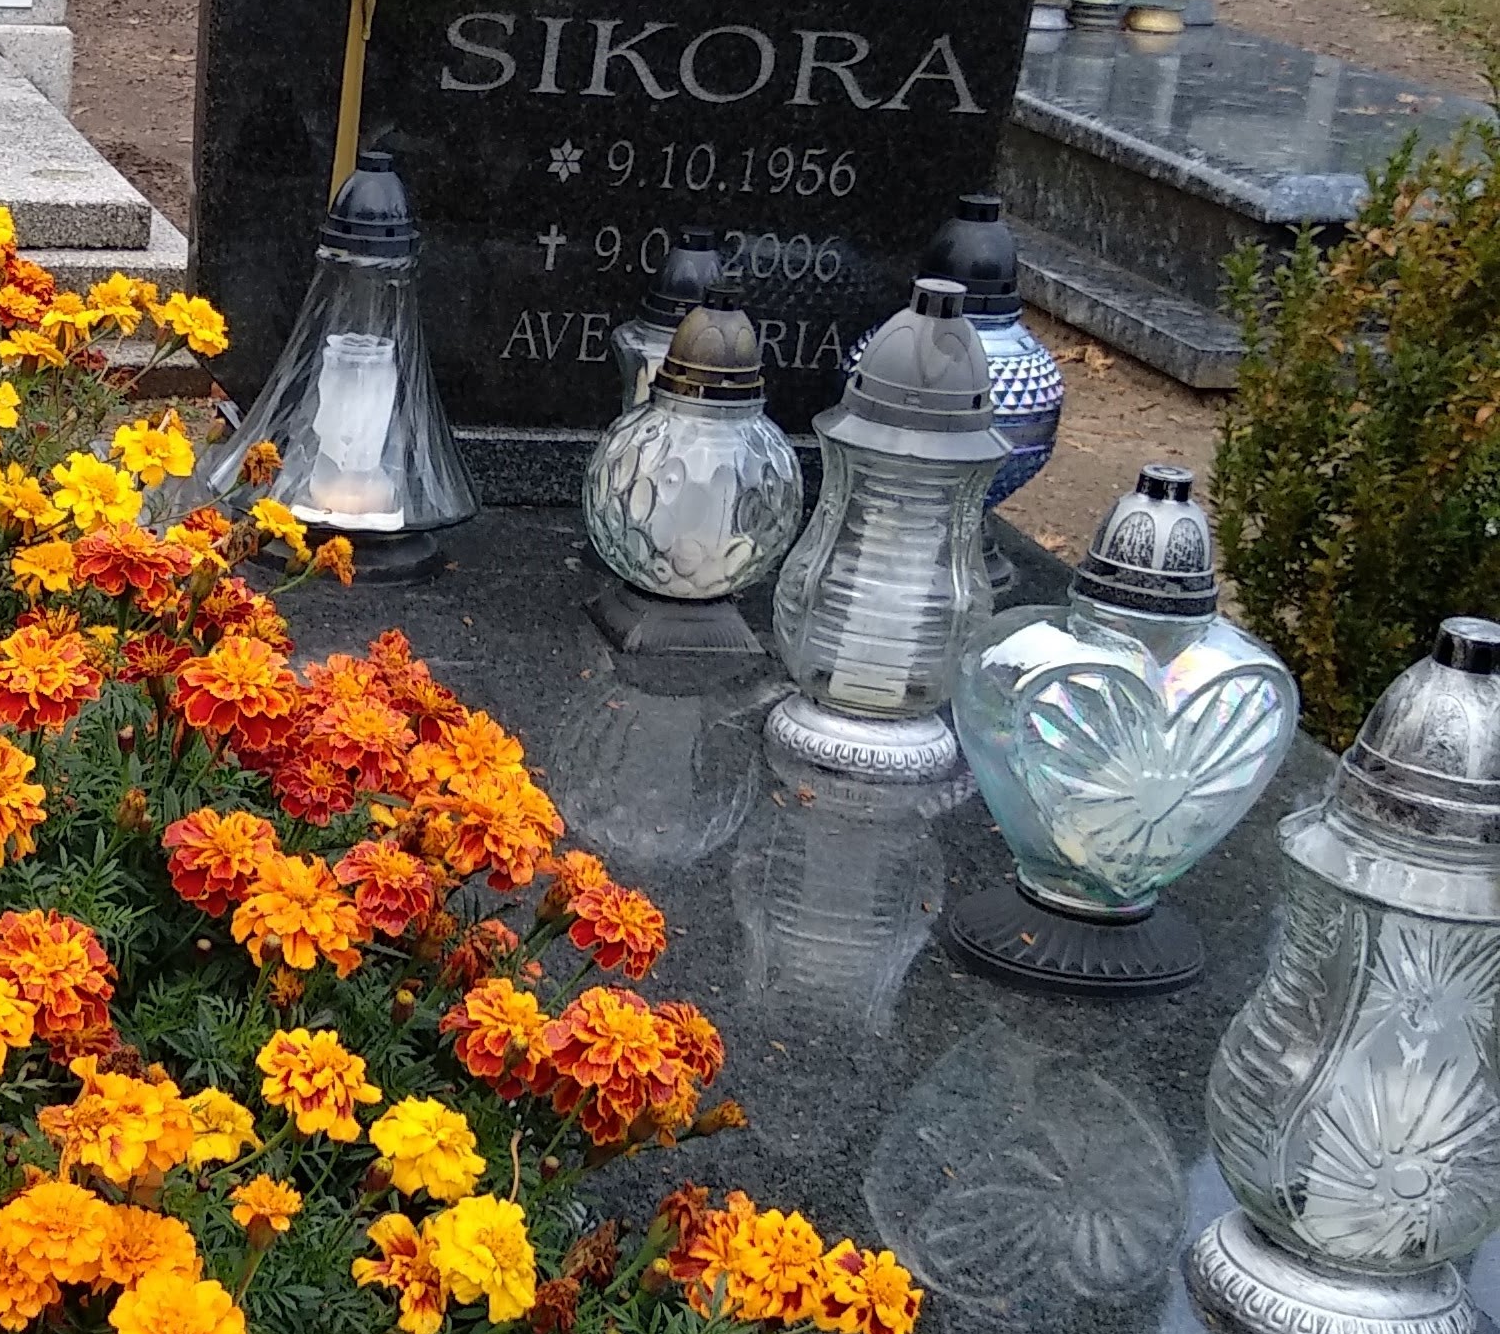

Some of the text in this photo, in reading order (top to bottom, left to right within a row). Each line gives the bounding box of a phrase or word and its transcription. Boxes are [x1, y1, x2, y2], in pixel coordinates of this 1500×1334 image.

[440, 12, 987, 114] SIKORA
[499, 310, 844, 369] AVE RIA
